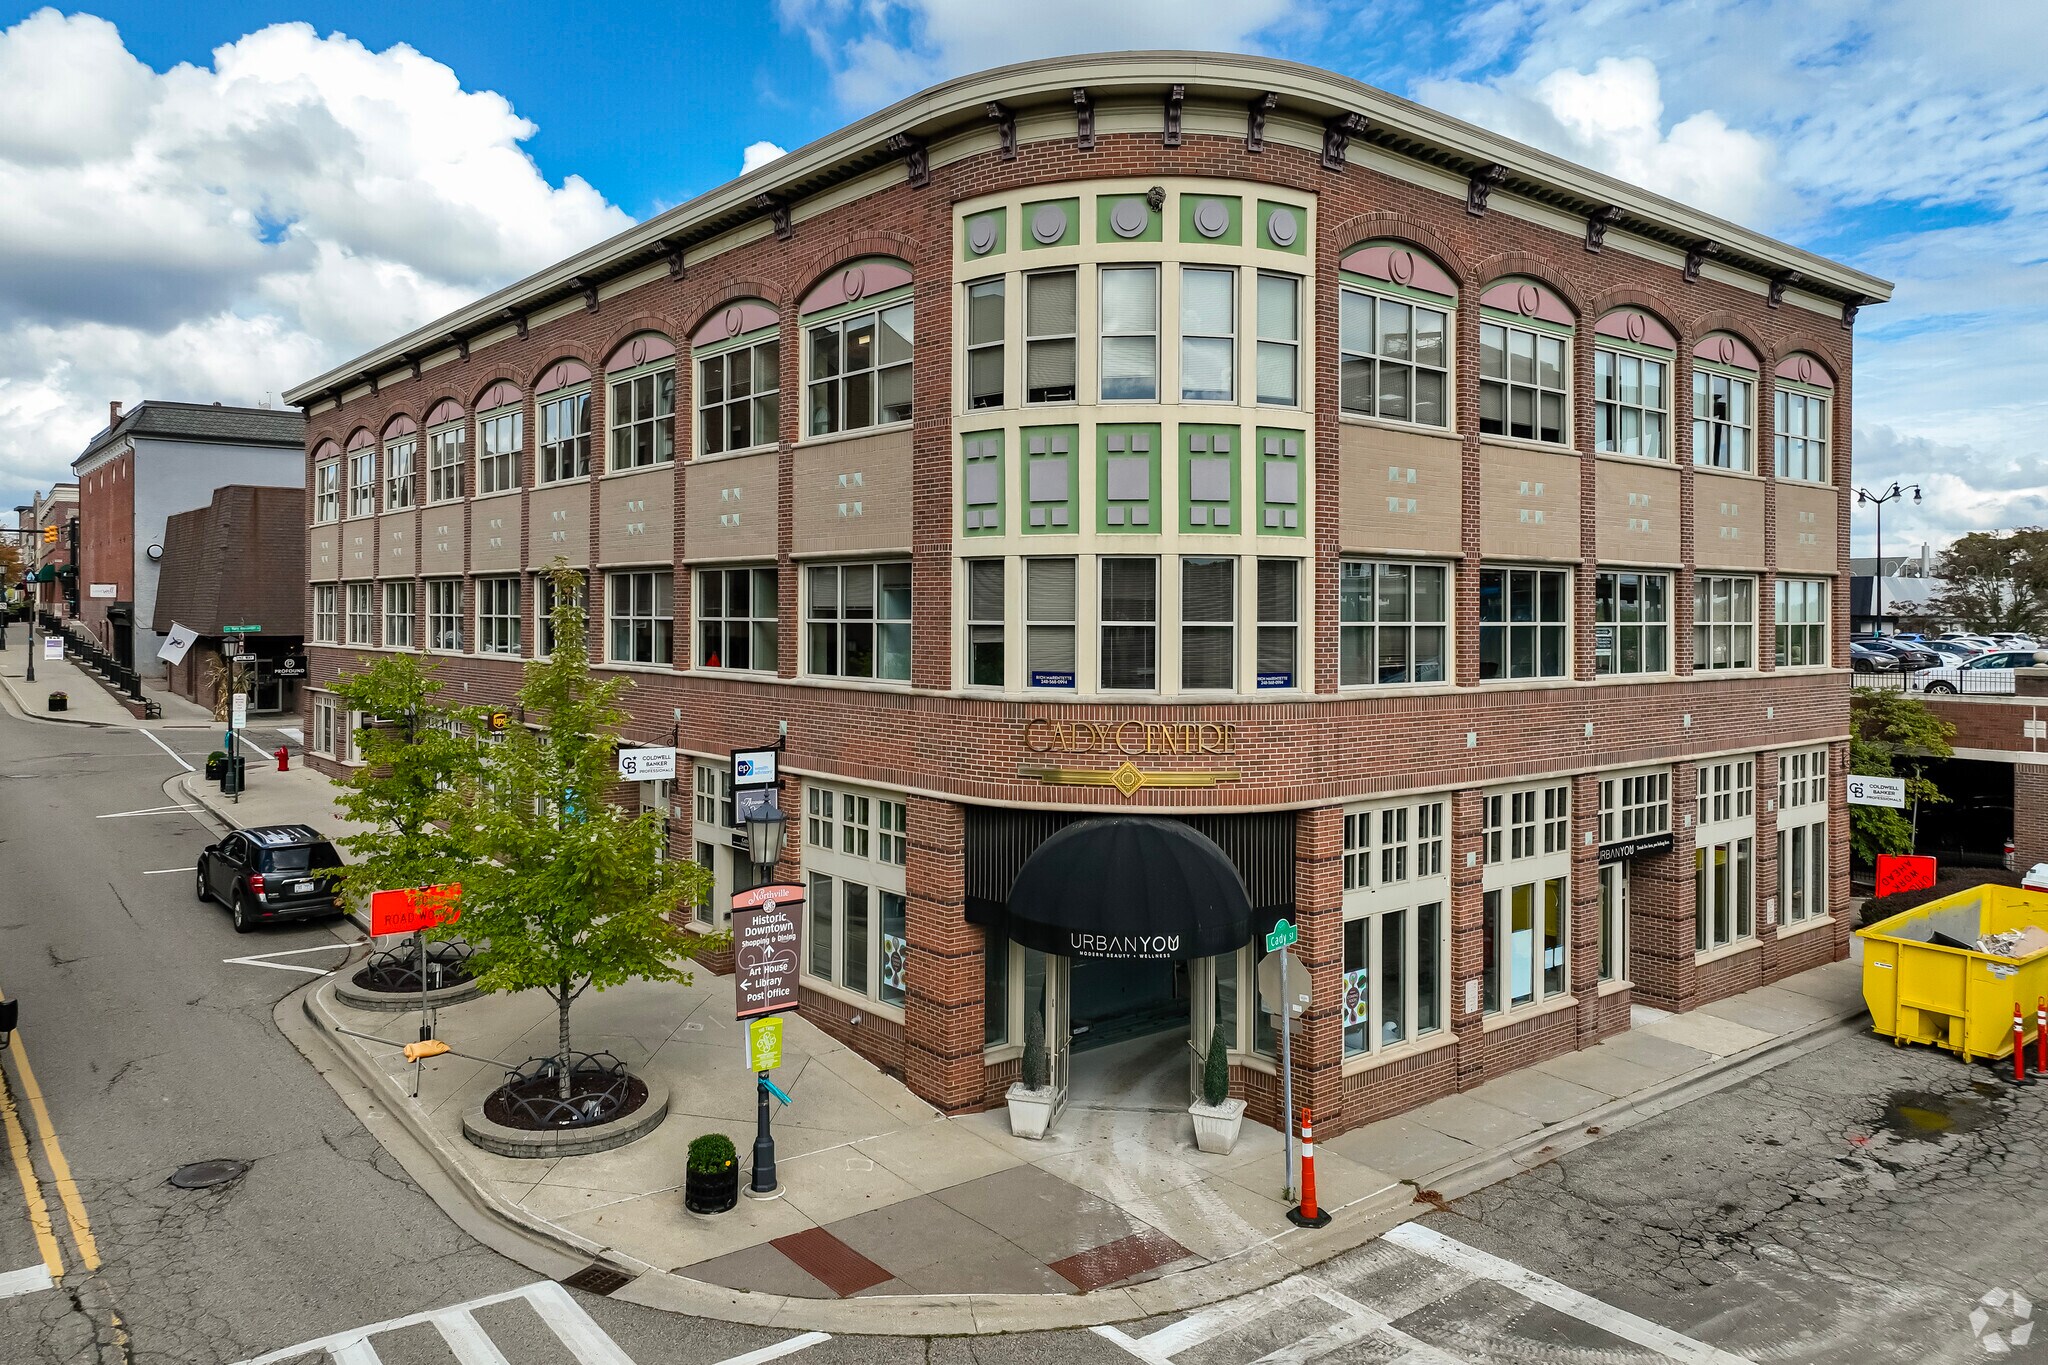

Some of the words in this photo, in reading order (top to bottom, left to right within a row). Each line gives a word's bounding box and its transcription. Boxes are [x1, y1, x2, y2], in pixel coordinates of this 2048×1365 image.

[1025, 717, 1113, 753] CADY
[1115, 720, 1237, 755] CENTRE
[738, 764, 749, 773] ep
[1881, 860, 1912, 886] AHEAD
[1893, 869, 1919, 891] WORK
[749, 888, 790, 903] Northville
[385, 912, 414, 926] ROAD
[752, 912, 787, 925] Historic
[745, 922, 793, 937] Downtown
[741, 937, 770, 947] Shopping
[777, 933, 797, 942] Dining
[1070, 932, 1180, 953] URBANYOU
[1270, 933, 1287, 947] Cady
[749, 966, 762, 976] Art
[764, 963, 788, 974] House
[755, 977, 783, 988] Library
[747, 991, 764, 1002] Post
[767, 988, 790, 998] Office
